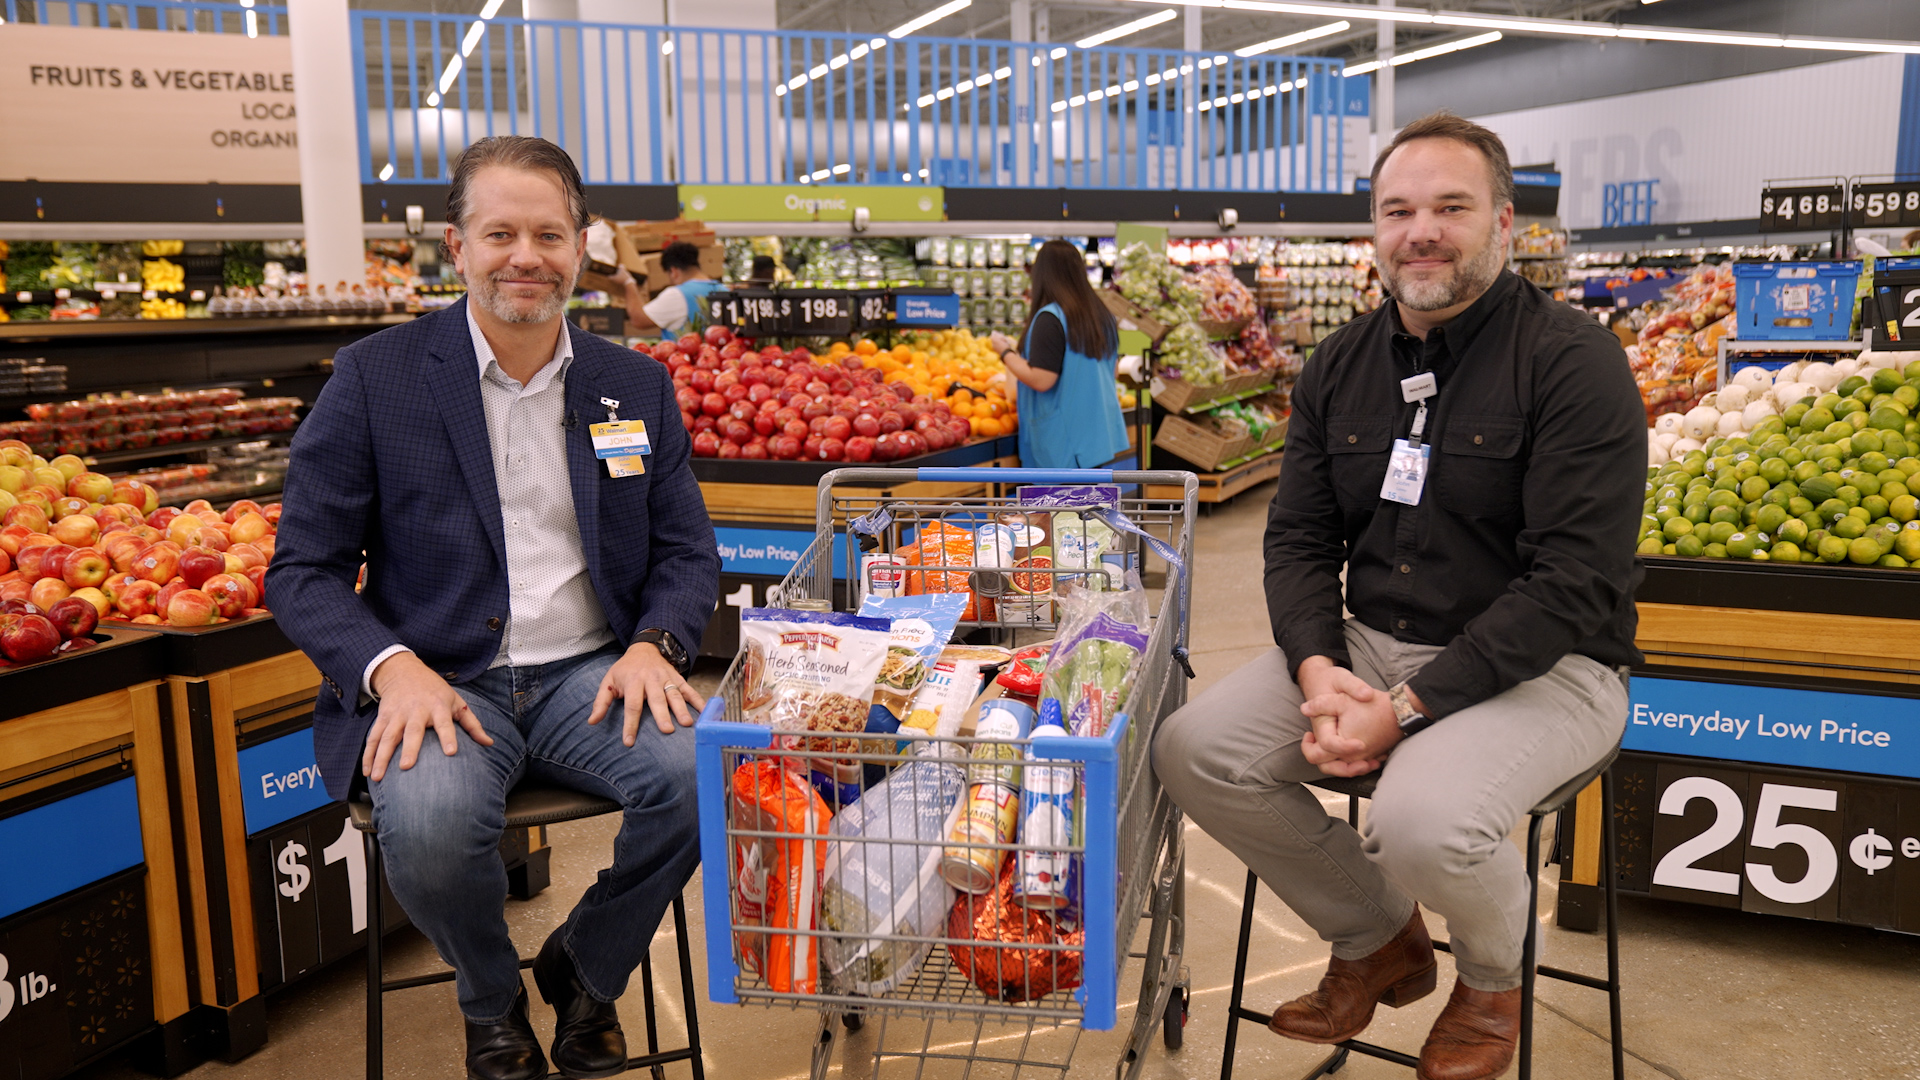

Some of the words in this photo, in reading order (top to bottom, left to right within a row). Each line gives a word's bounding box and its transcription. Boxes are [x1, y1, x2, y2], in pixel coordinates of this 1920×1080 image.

[29, 65, 123, 88] FRUITS
[131, 68, 148, 88] &
[154, 69, 294, 93] VEGETABLE
[784, 193, 847, 214] Organic
[1602, 178, 1660, 228] BEEF
[1408, 383, 1432, 393] WALMART
[609, 436, 633, 446] JOHN
[1387, 491, 1396, 500] 15
[739, 544, 765, 559] Low
[766, 545, 799, 561] Price
[766, 650, 795, 670] Herb
[796, 655, 850, 676] Seasoned
[1632, 703, 1751, 740] Everyday
[1757, 714, 1812, 740] Low
[1819, 719, 1891, 748] Price
[19, 971, 57, 1006] lb.
